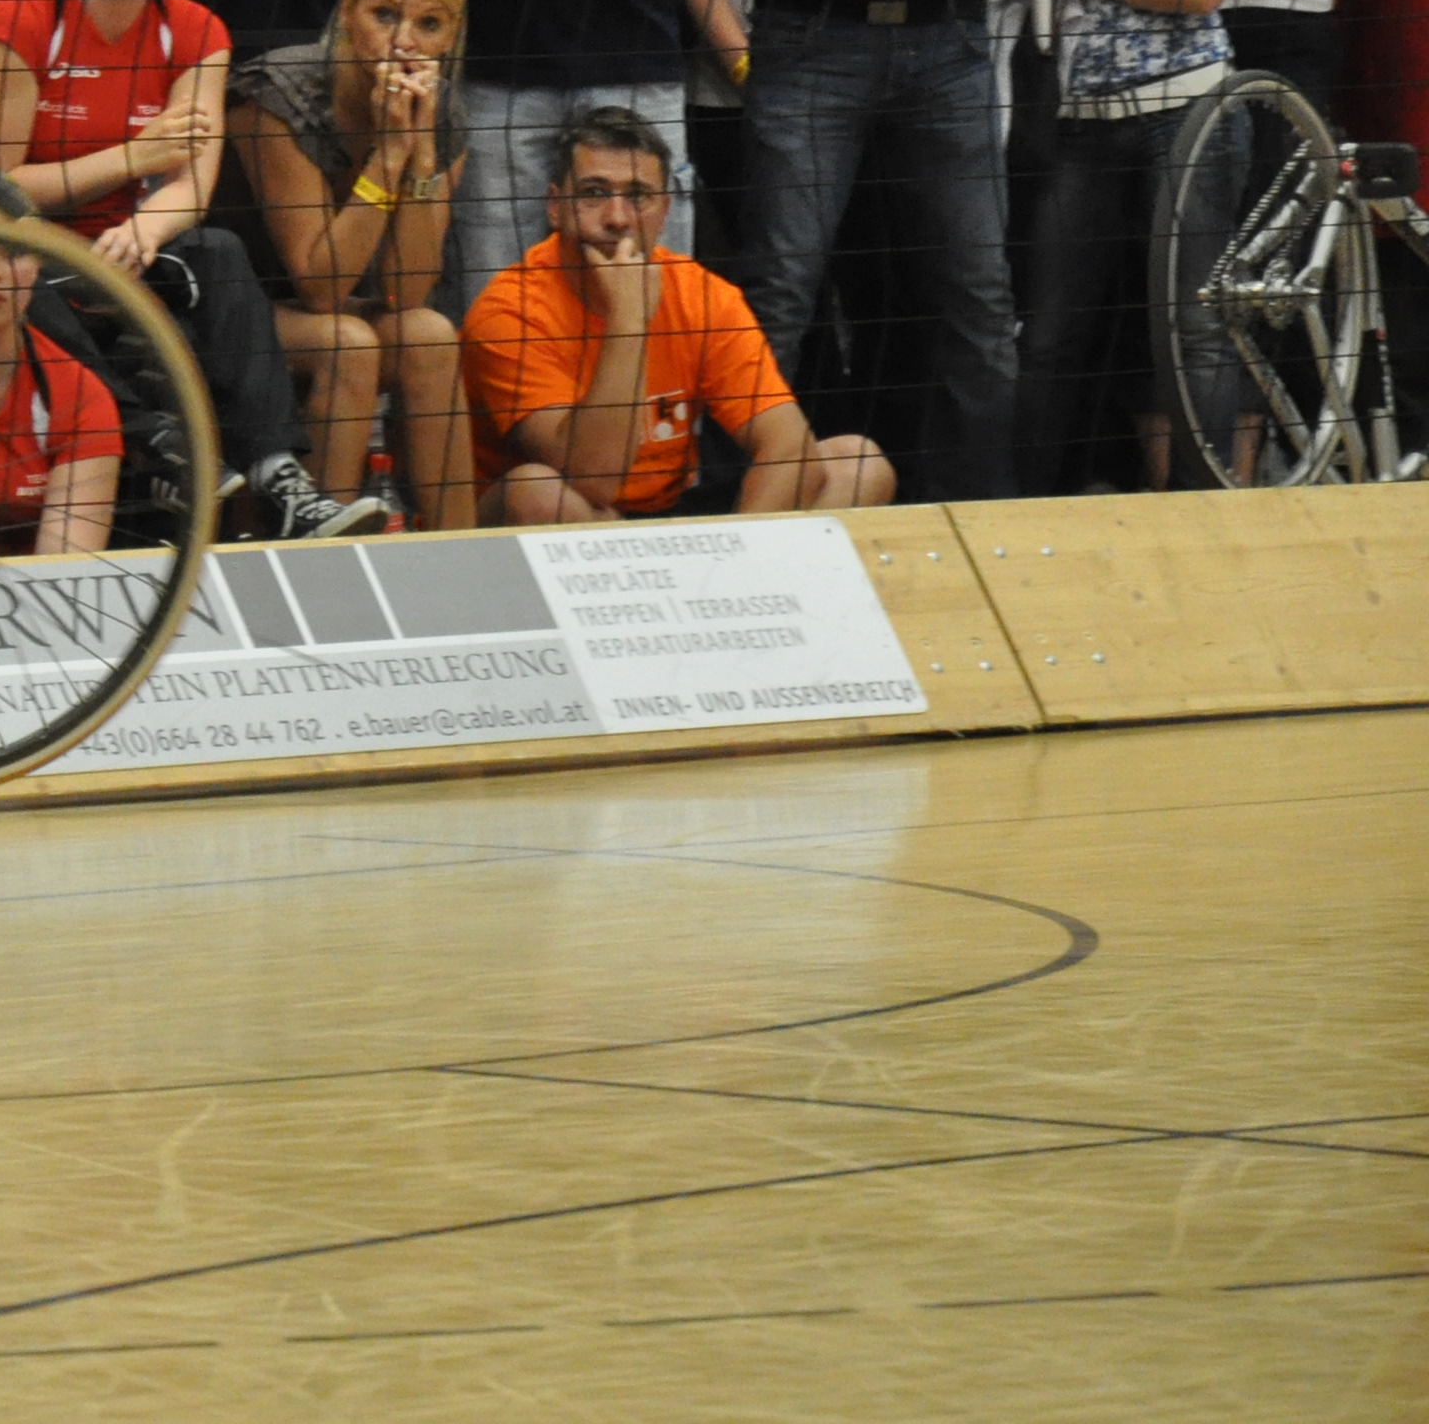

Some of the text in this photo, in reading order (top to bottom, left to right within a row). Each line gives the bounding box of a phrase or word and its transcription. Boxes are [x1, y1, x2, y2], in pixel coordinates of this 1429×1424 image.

[542, 532, 749, 564] IM GARTENBEREICH
[556, 564, 680, 596] VORPLÄTZE
[570, 594, 803, 627] TREPPEN TERRASSEN
[584, 626, 809, 660] REPARATURARBEITEN
[213, 647, 569, 699] PLATTENVERLEGUNG
[610, 678, 918, 720] INNEN- UND AUSSENBEREICH
[206, 723, 239, 748] 28
[243, 719, 274, 745] 44
[281, 717, 326, 744] 762
[348, 701, 590, 737] e.bauer@cable.vol.at
